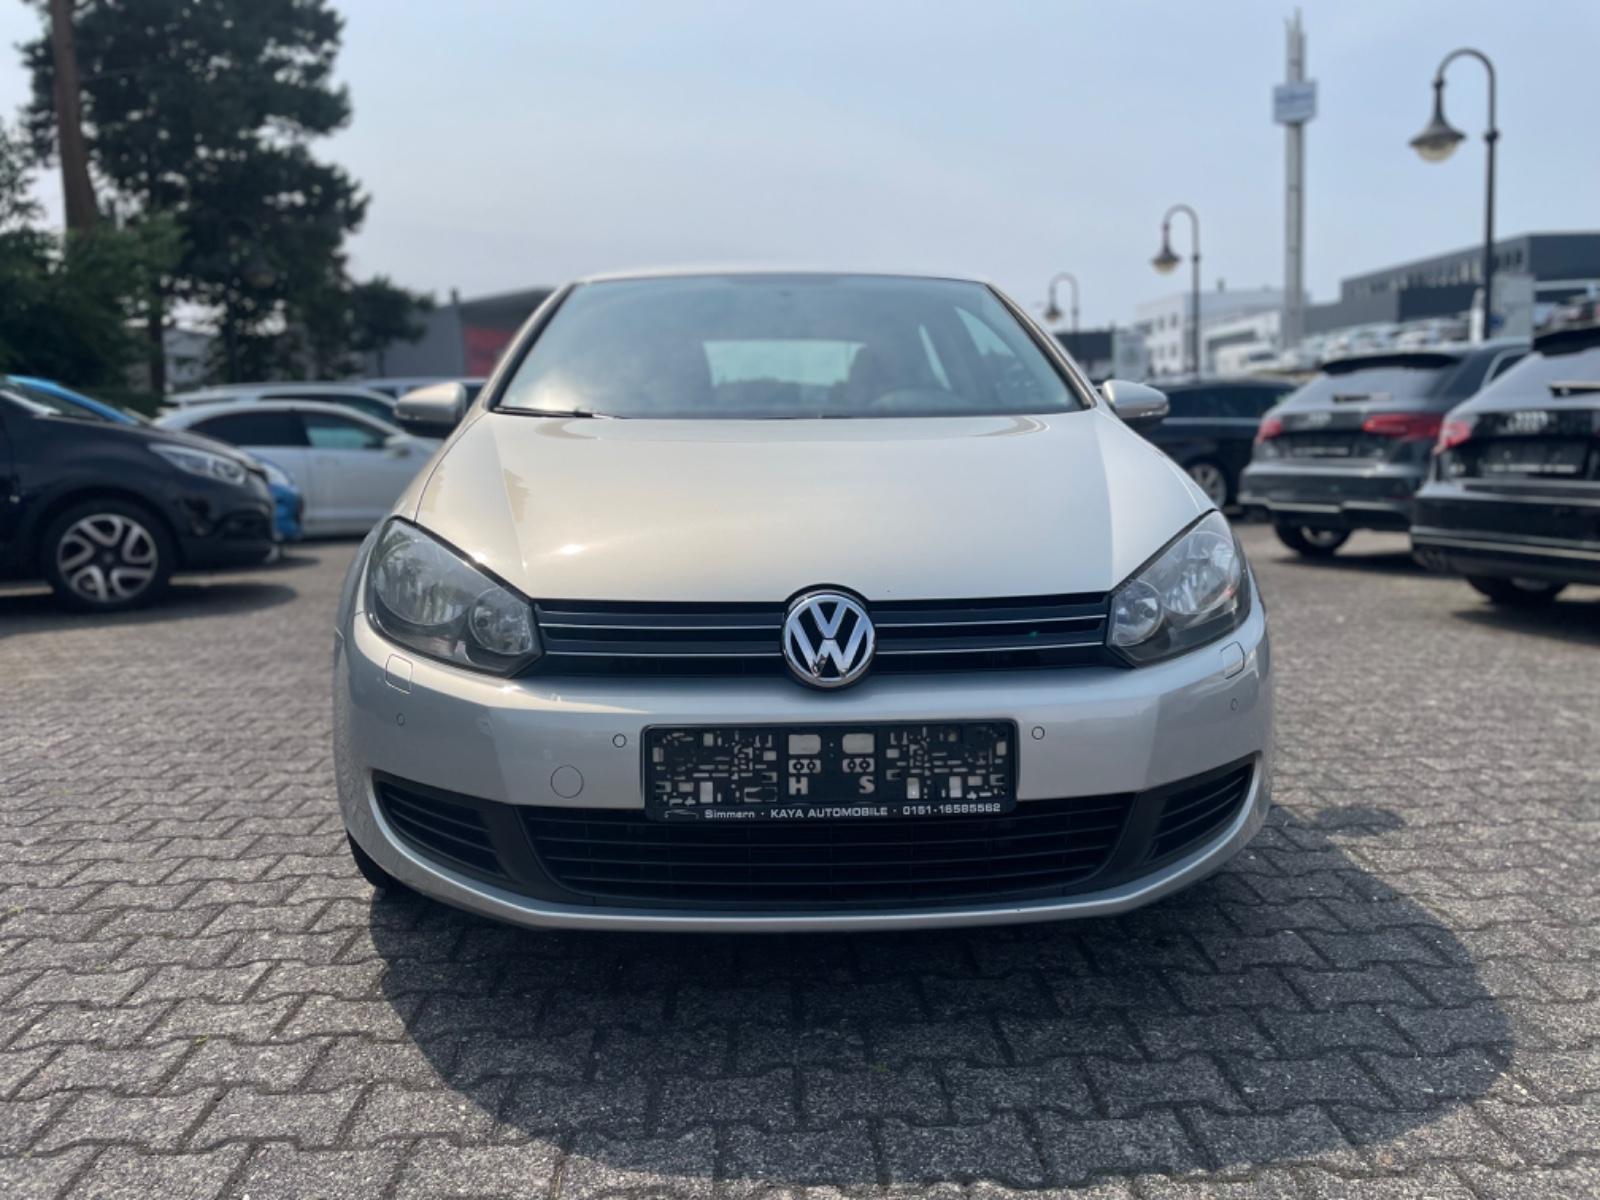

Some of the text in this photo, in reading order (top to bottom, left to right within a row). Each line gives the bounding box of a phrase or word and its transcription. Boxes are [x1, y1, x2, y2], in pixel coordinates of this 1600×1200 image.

[704, 809, 755, 819] Simmern
[770, 808, 804, 818] KAYA
[807, 806, 888, 818] AUTOMOBILE
